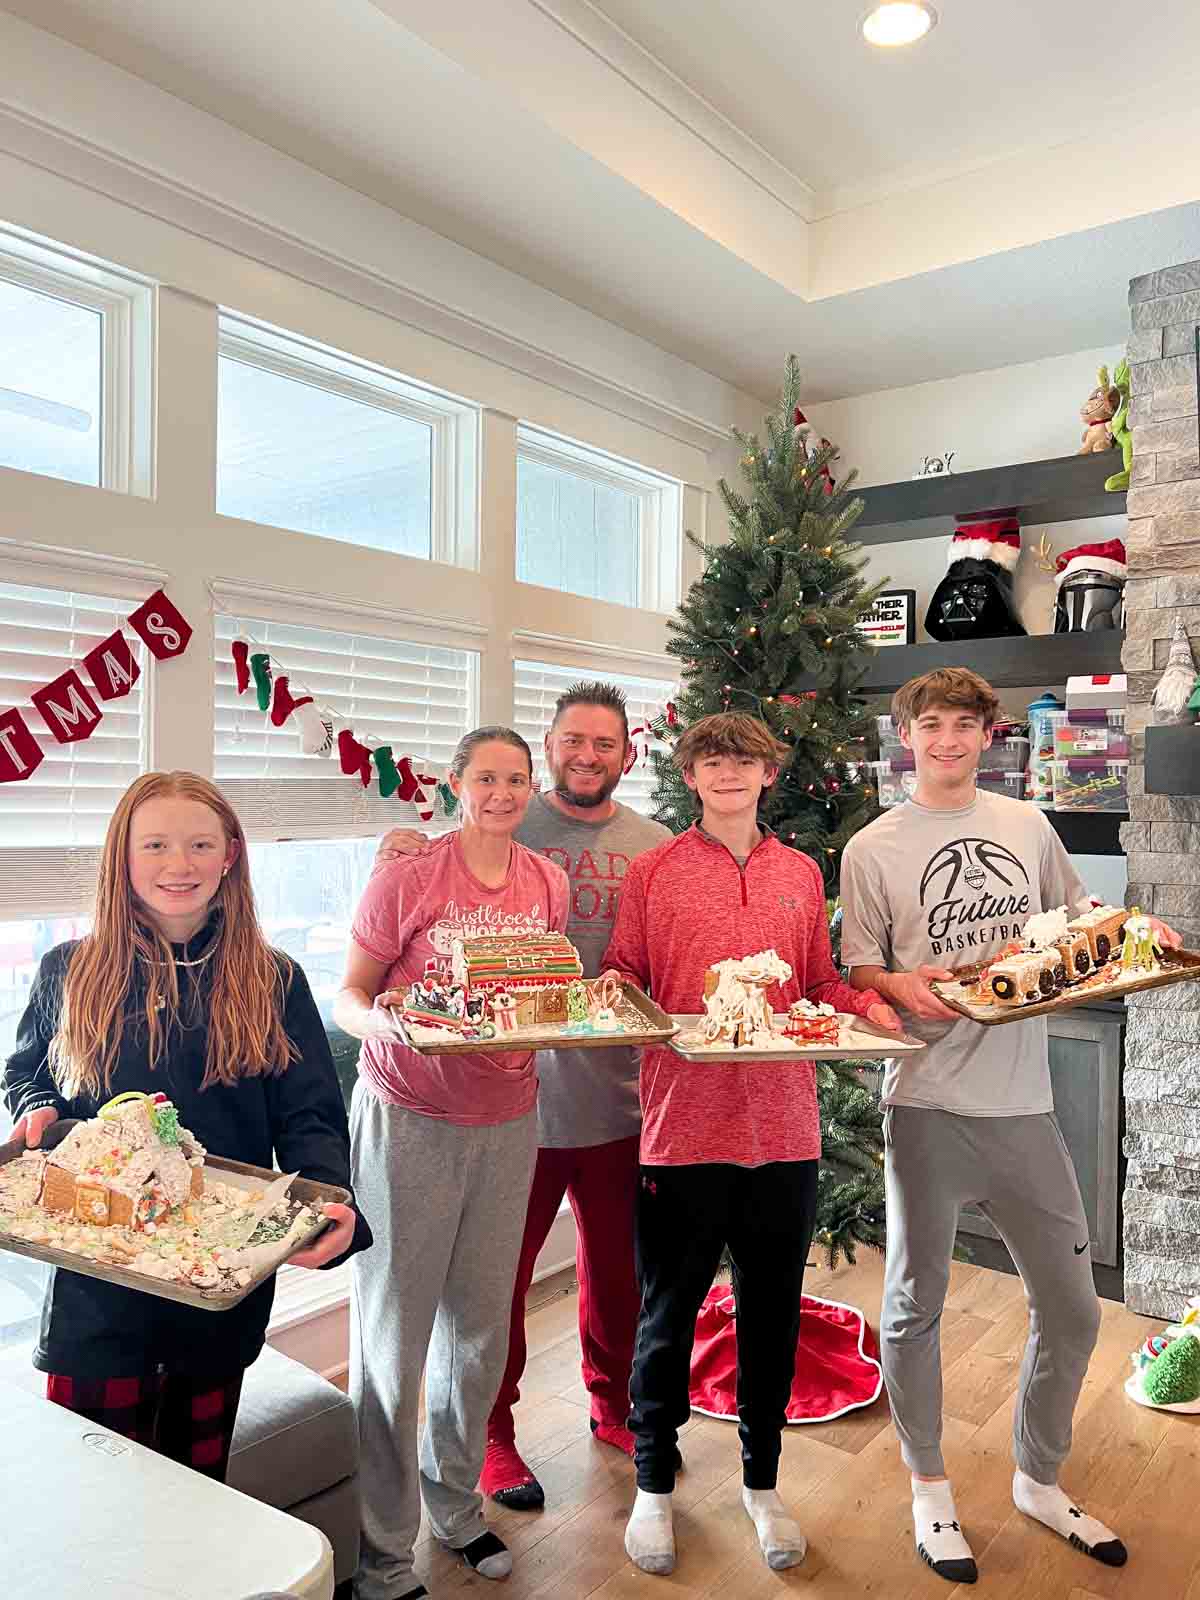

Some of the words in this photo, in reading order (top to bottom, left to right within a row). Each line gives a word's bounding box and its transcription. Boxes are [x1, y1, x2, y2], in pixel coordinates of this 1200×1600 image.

[876, 599, 904, 609] THEIR
[443, 900, 525, 925] Mistletoe
[928, 892, 1029, 939] Future
[931, 923, 1022, 955] BASKETBA
